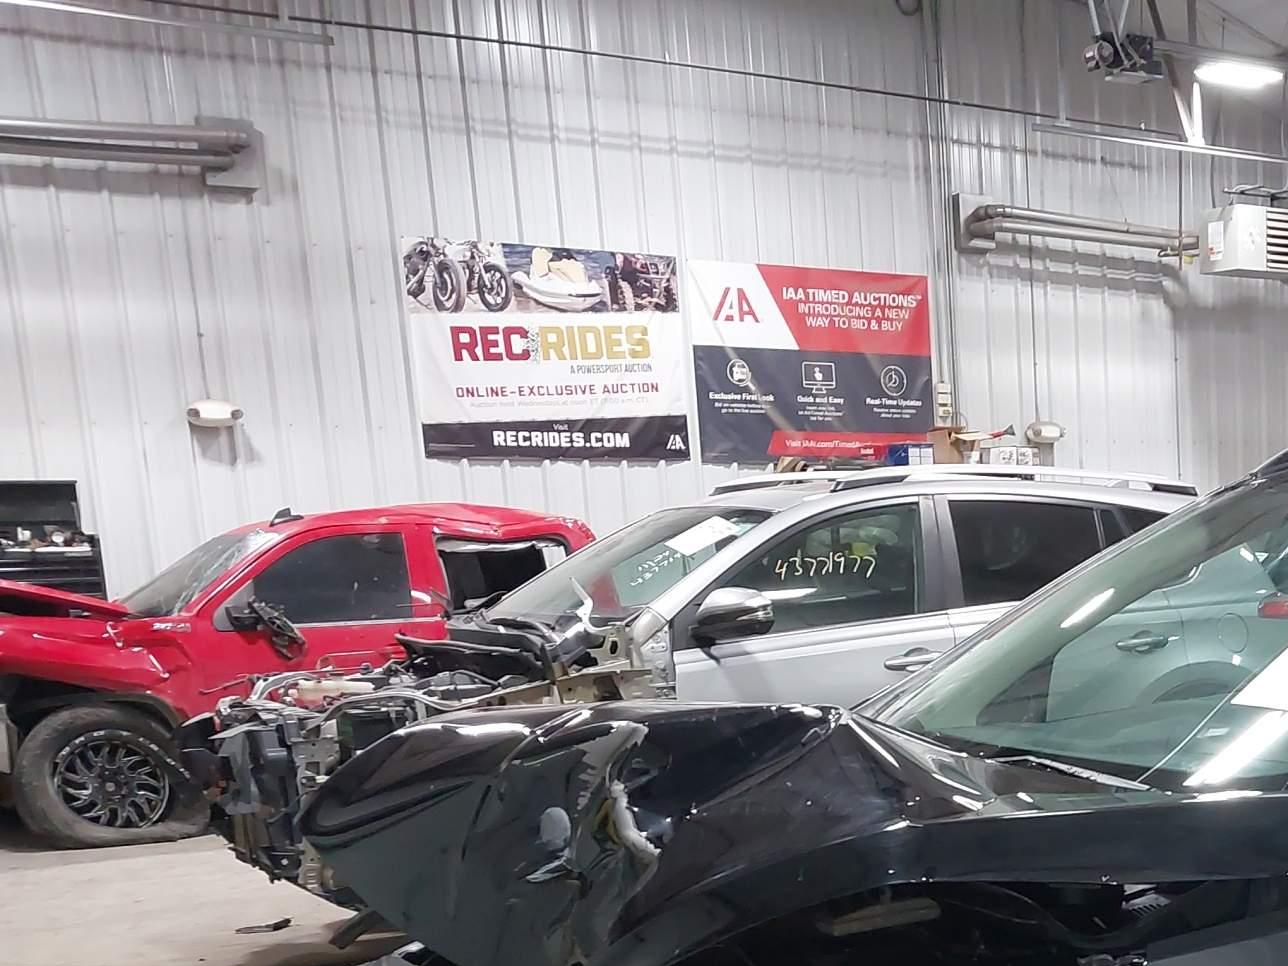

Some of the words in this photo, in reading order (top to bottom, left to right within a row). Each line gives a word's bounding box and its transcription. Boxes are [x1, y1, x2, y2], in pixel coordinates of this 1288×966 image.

[782, 286, 805, 301] IAA
[806, 288, 849, 304] TIMED
[798, 302, 872, 318] INTRODUCING
[874, 308, 883, 318] A
[884, 308, 909, 320] NEW
[805, 316, 830, 328] WAY
[833, 317, 848, 328] TO
[850, 318, 868, 330] BID
[870, 319, 879, 330] &
[881, 320, 903, 331] BUY
[449, 325, 531, 361] REC
[539, 325, 652, 361] RIDES
[570, 364, 576, 375] A
[577, 363, 622, 375] POWERSPORT
[624, 363, 653, 373] AUCTION
[456, 383, 596, 398] ONLINE-EXCLUSIVE
[602, 382, 660, 394] AUCTION
[709, 391, 741, 401] Exclusive
[742, 392, 758, 401] First
[797, 395, 814, 404] Quick
[815, 395, 828, 404] and
[829, 396, 844, 405] Easy
[866, 397, 897, 406] Real-Time
[553, 423, 569, 431] Visit
[493, 430, 631, 448] RECRIDES.COM
[785, 439, 801, 448] Visit
